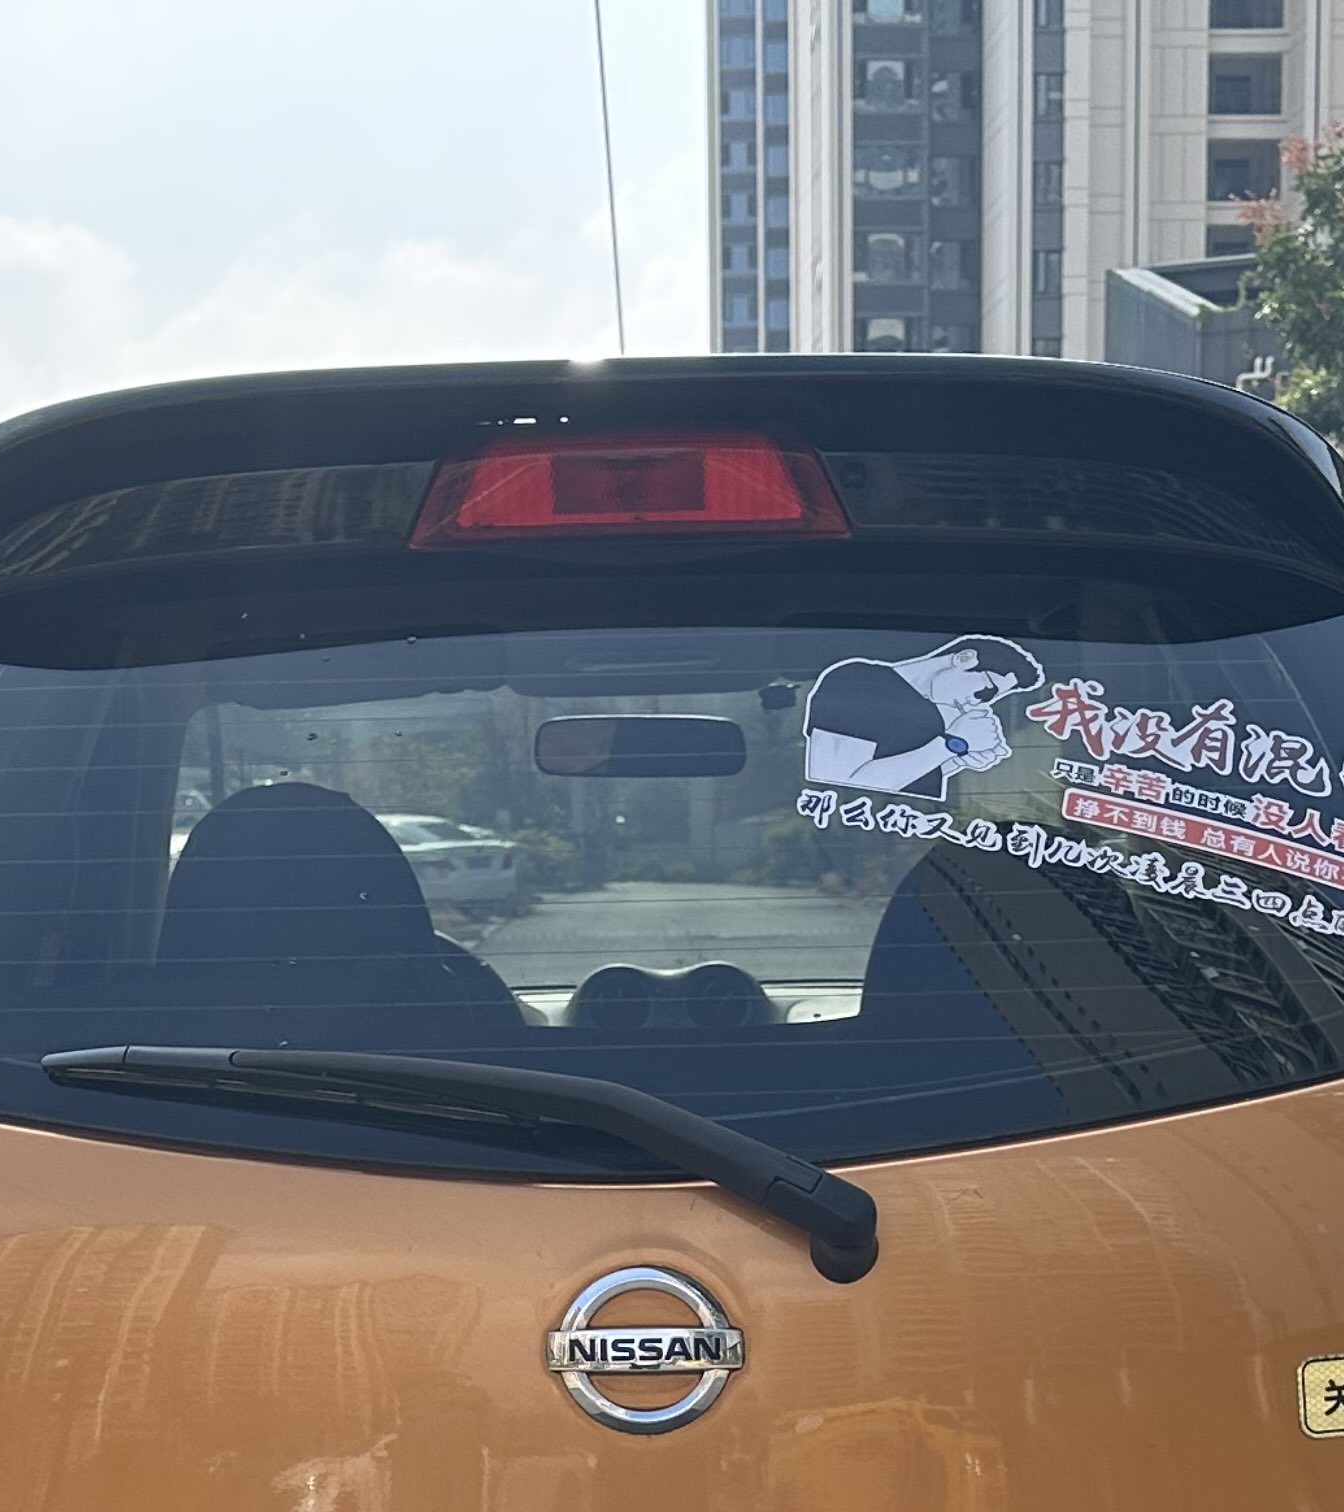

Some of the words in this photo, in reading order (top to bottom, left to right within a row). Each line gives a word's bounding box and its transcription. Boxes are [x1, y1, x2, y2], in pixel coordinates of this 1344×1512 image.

[1073, 798, 1189, 844] 挣不到钱
[568, 1337, 721, 1362] NISSAN
